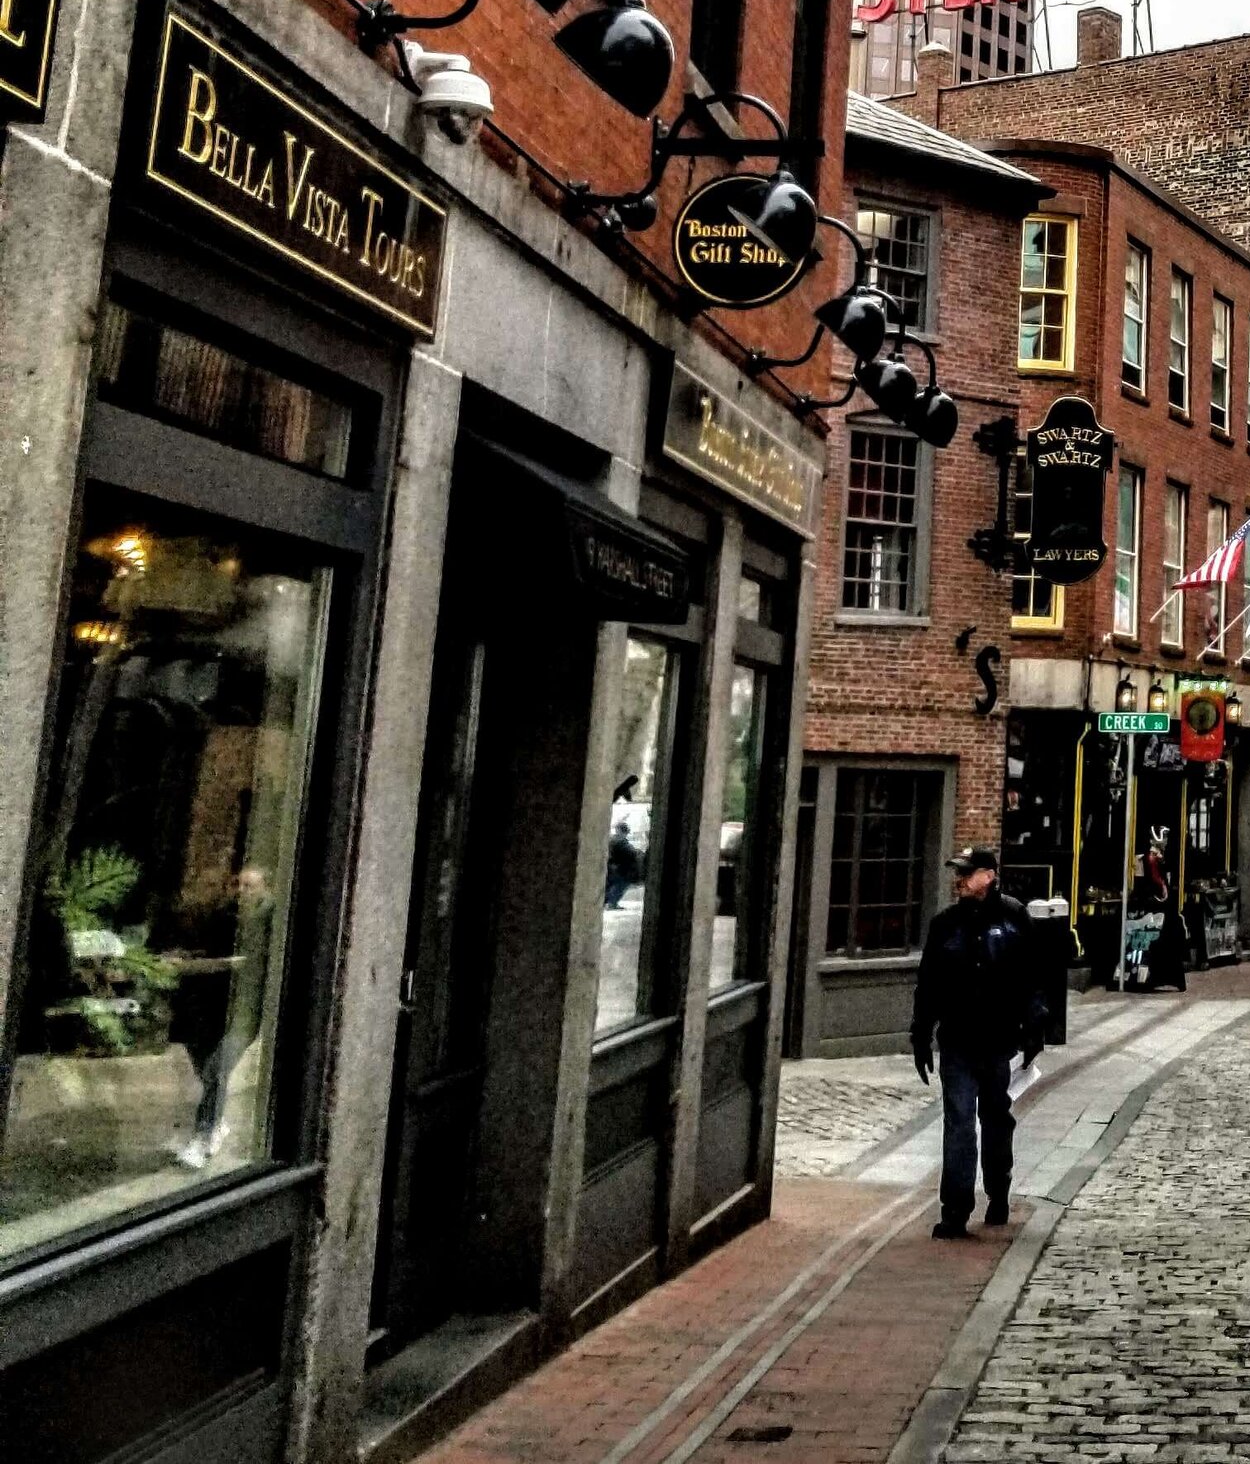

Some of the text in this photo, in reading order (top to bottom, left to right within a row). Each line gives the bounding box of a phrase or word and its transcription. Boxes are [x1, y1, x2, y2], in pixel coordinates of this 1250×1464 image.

[684, 219, 748, 238] Boston
[690, 240, 731, 264] Gift
[1037, 427, 1104, 446] SWARTZ
[1065, 439, 1076, 451] &
[1038, 451, 1102, 469] SWARTZ
[1033, 548, 1100, 561] LAWYERS
[1105, 715, 1147, 730] CREEK
